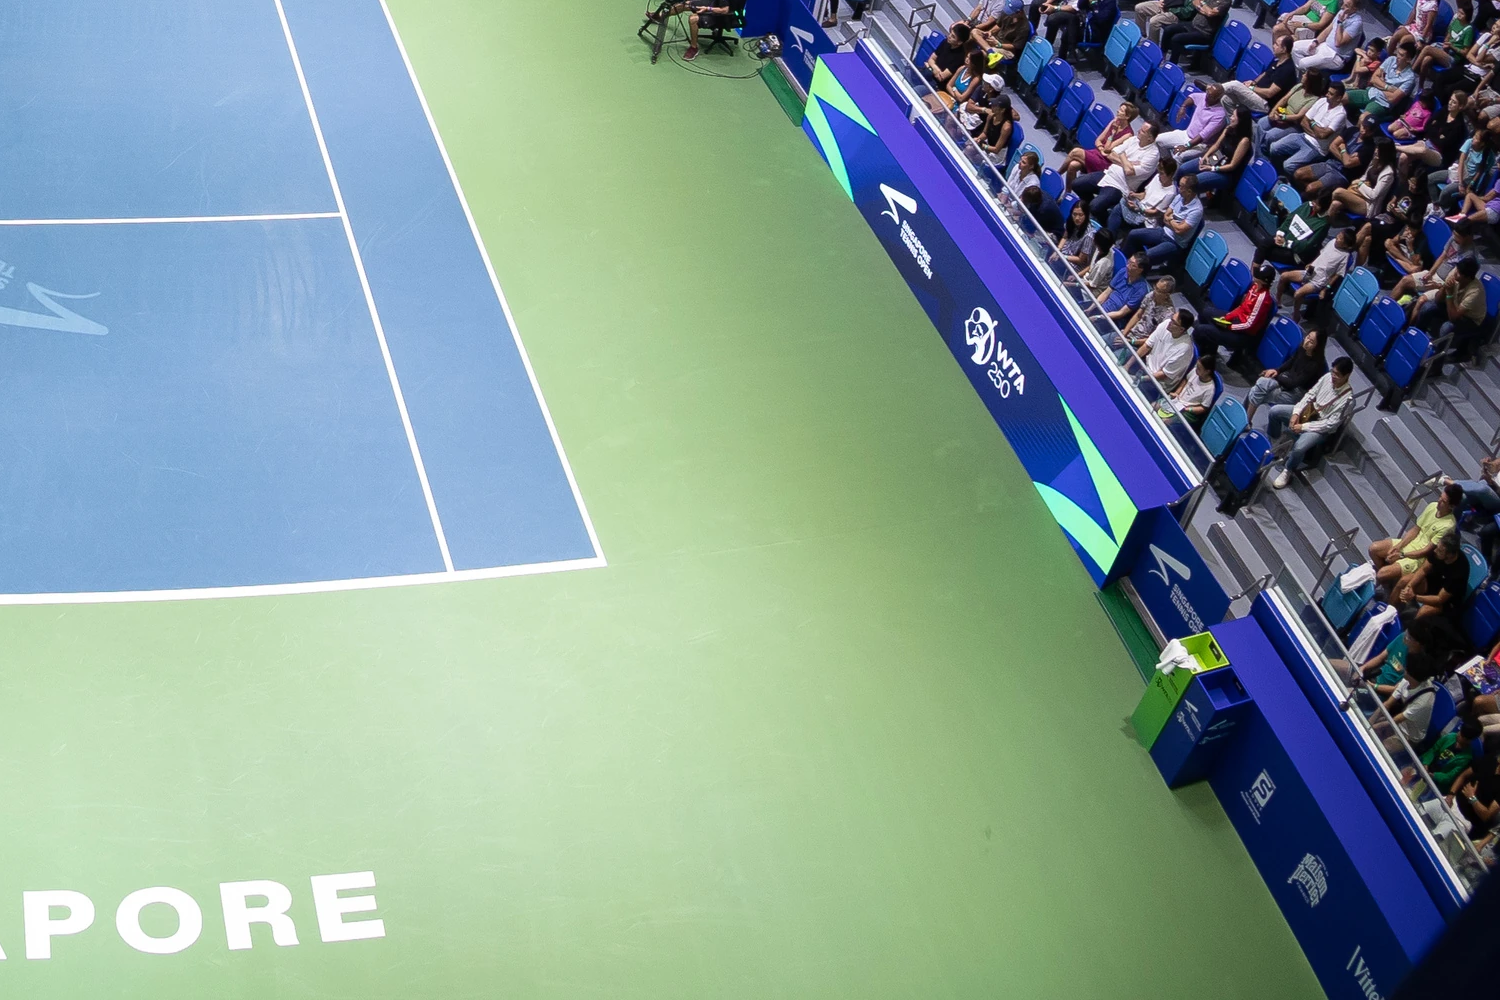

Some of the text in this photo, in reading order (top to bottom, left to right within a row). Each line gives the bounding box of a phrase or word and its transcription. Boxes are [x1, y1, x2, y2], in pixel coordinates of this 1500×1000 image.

[900, 228, 933, 280] TENNIS OPEN
[901, 219, 932, 265] SINGAPORE
[987, 361, 1010, 398] 250
[998, 341, 1025, 395] WTA
[1169, 590, 1189, 622] TENNIS
[1171, 583, 1205, 632] SINGAPORE
[1287, 863, 1319, 909] Perrier
[1300, 852, 1328, 899] Maison
[1354, 956, 1384, 1000] Vitte
